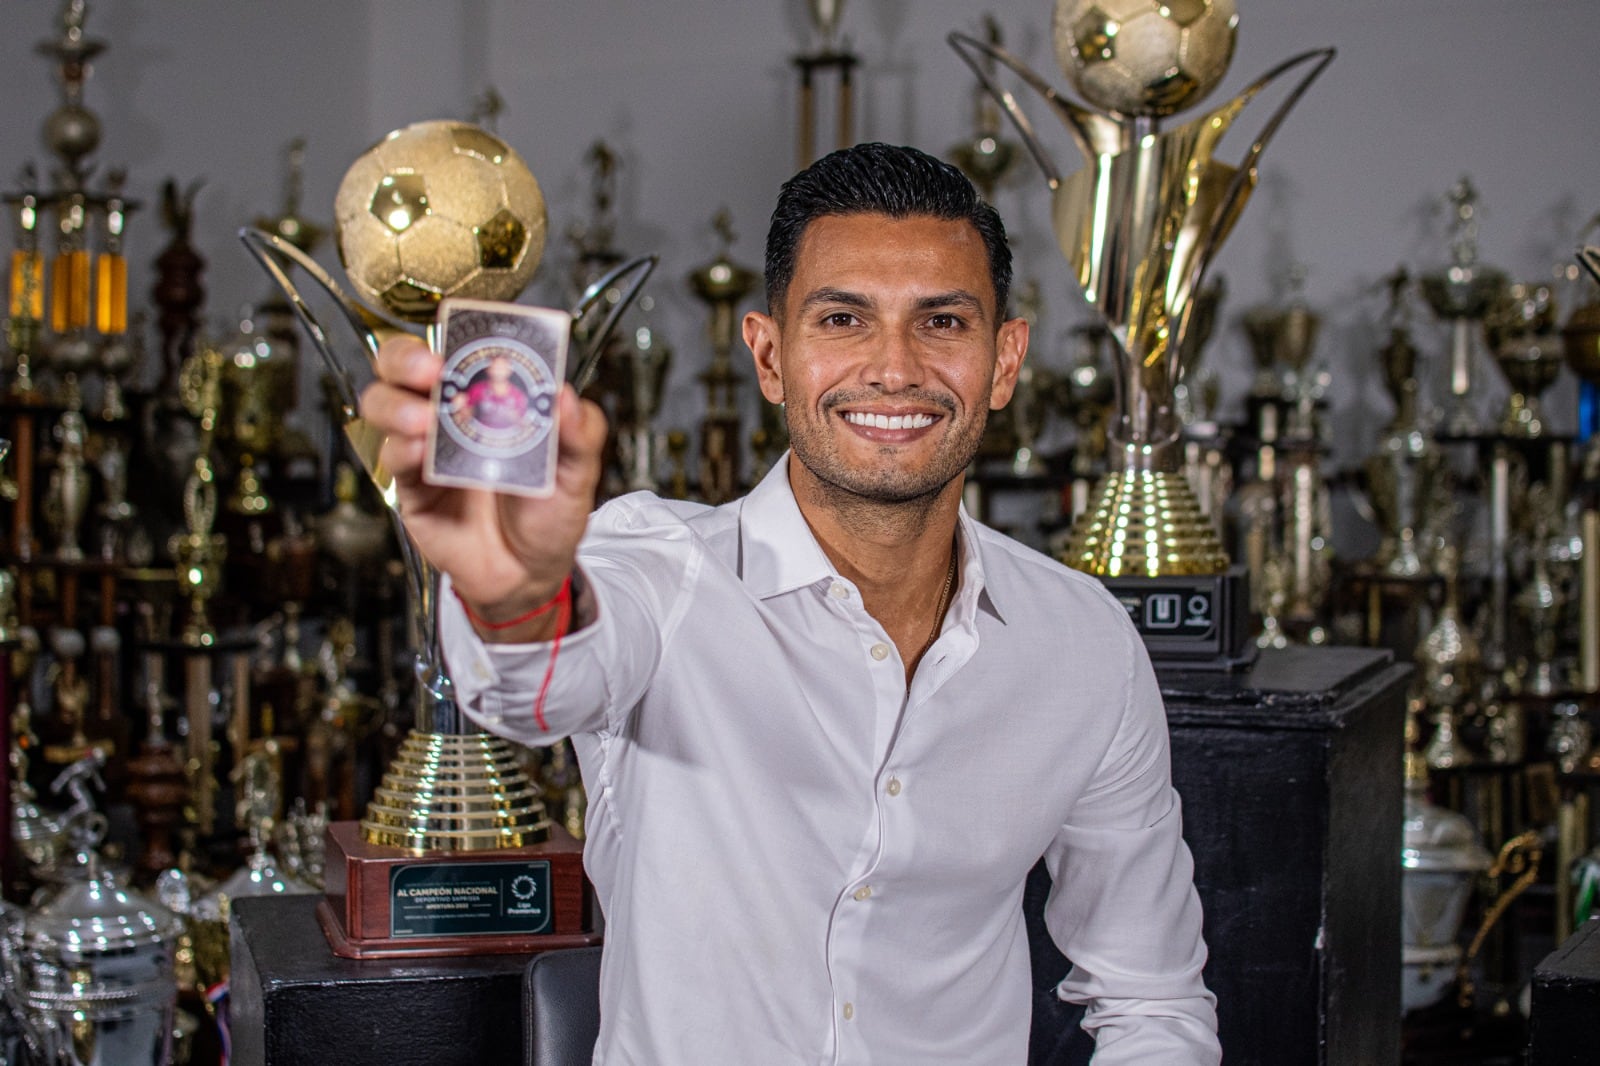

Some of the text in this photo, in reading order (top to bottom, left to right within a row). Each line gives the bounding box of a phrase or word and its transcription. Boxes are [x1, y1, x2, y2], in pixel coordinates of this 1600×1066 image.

[397, 886, 498, 897] AL CAMPEÓN NACIONAL
